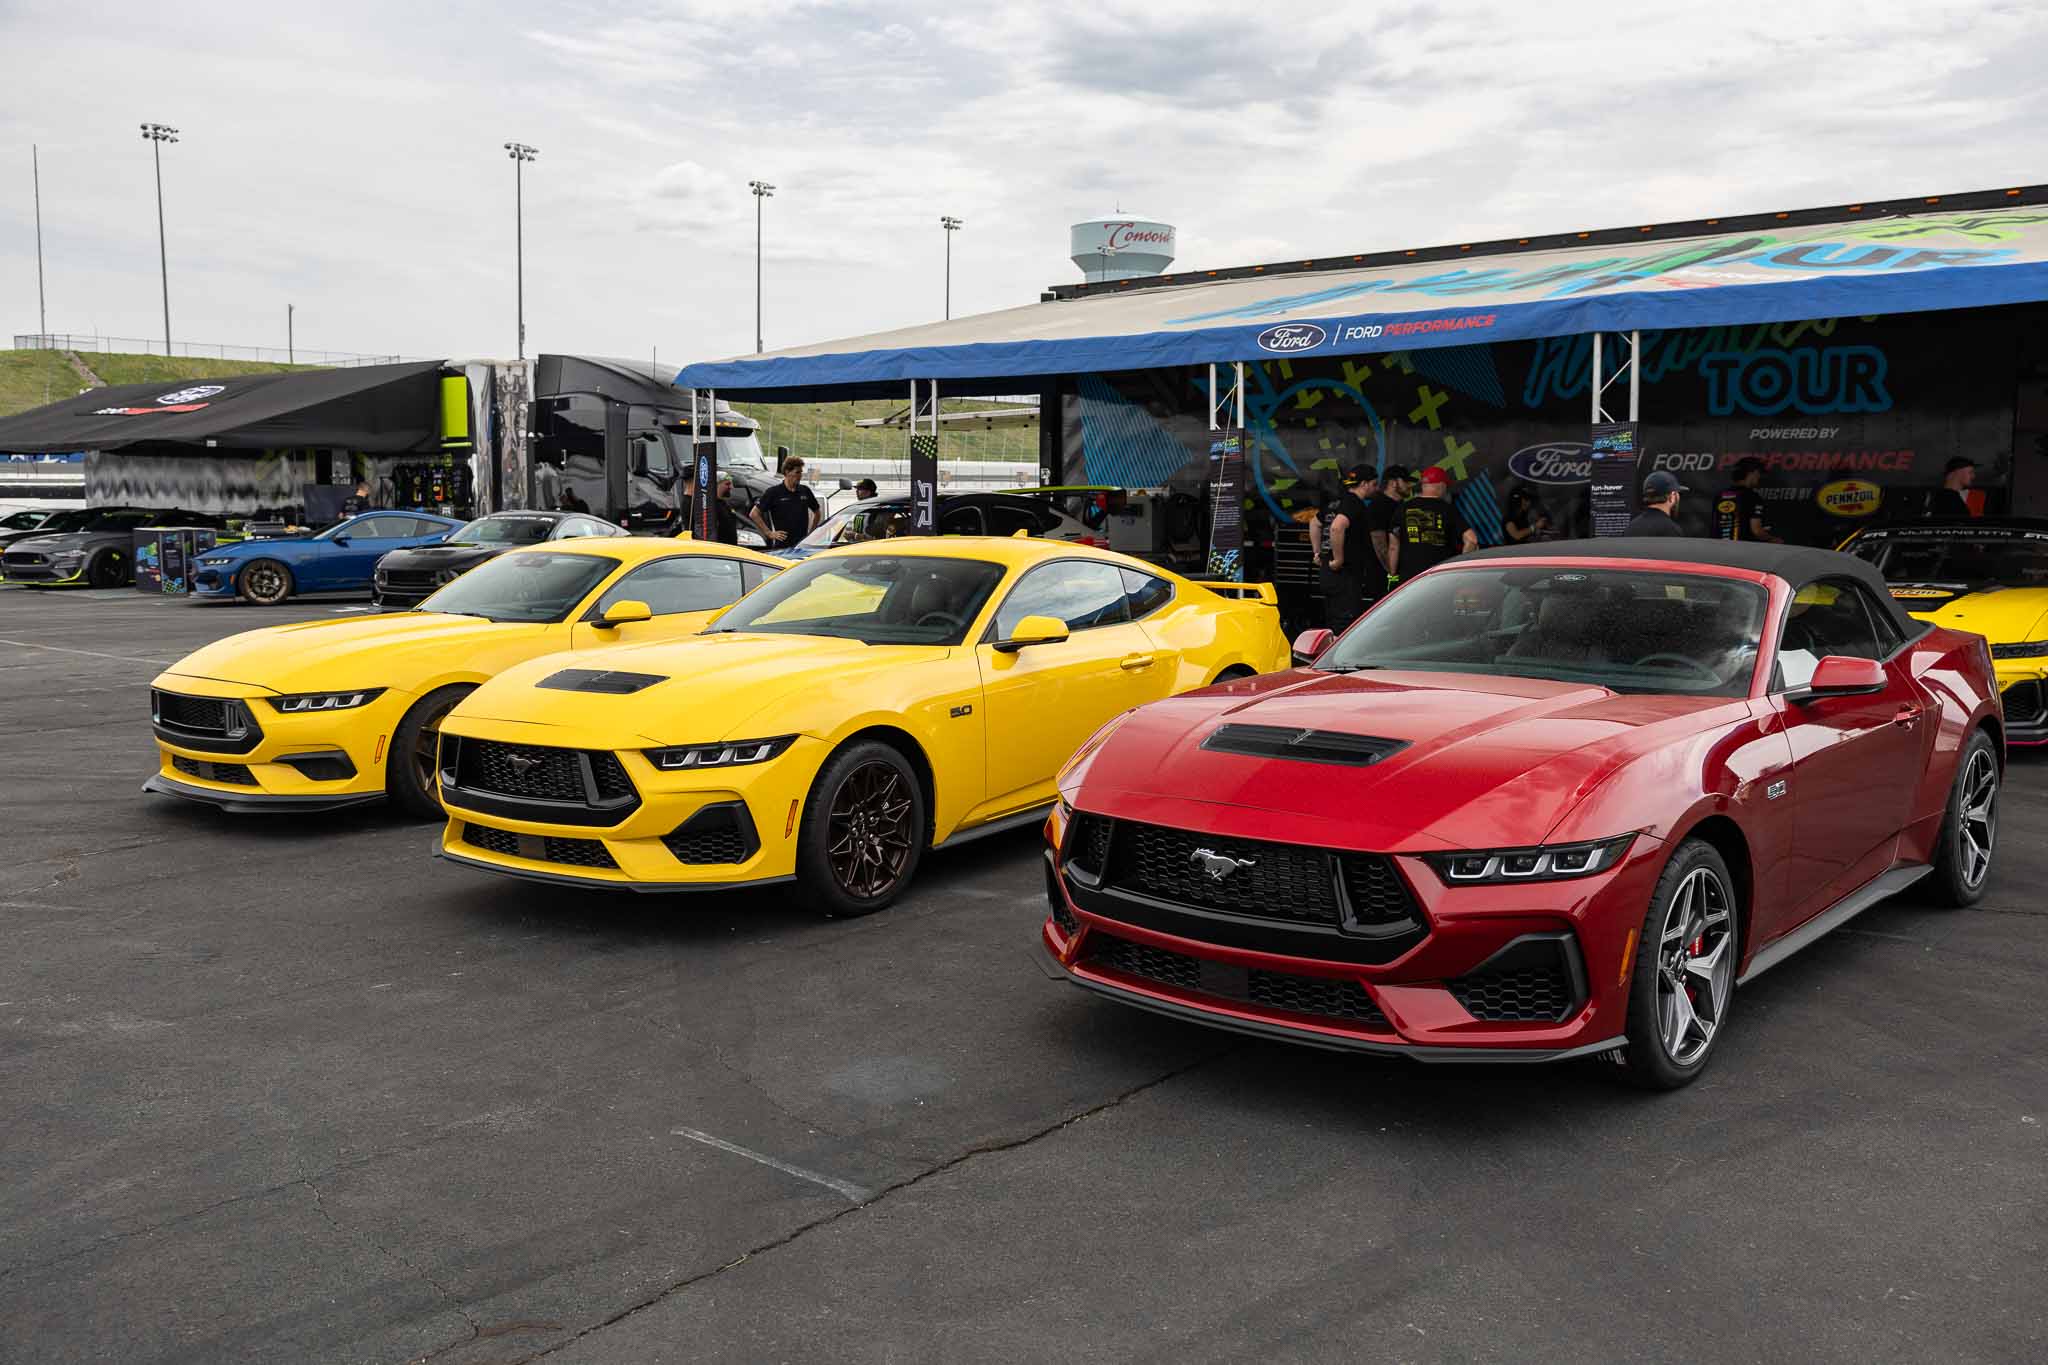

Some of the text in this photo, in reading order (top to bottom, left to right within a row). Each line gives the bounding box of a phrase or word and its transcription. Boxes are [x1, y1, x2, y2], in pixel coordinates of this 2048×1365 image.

[1104, 222, 1171, 251] Concord
[1269, 327, 1313, 349] Ford
[1345, 314, 1497, 341] FORD PERFORMANCE
[1701, 345, 1894, 416] TOUR
[1749, 427, 1840, 440] POWERED BY
[1652, 453, 1715, 472] FORD
[1825, 489, 1876, 505] PENNZOIL
